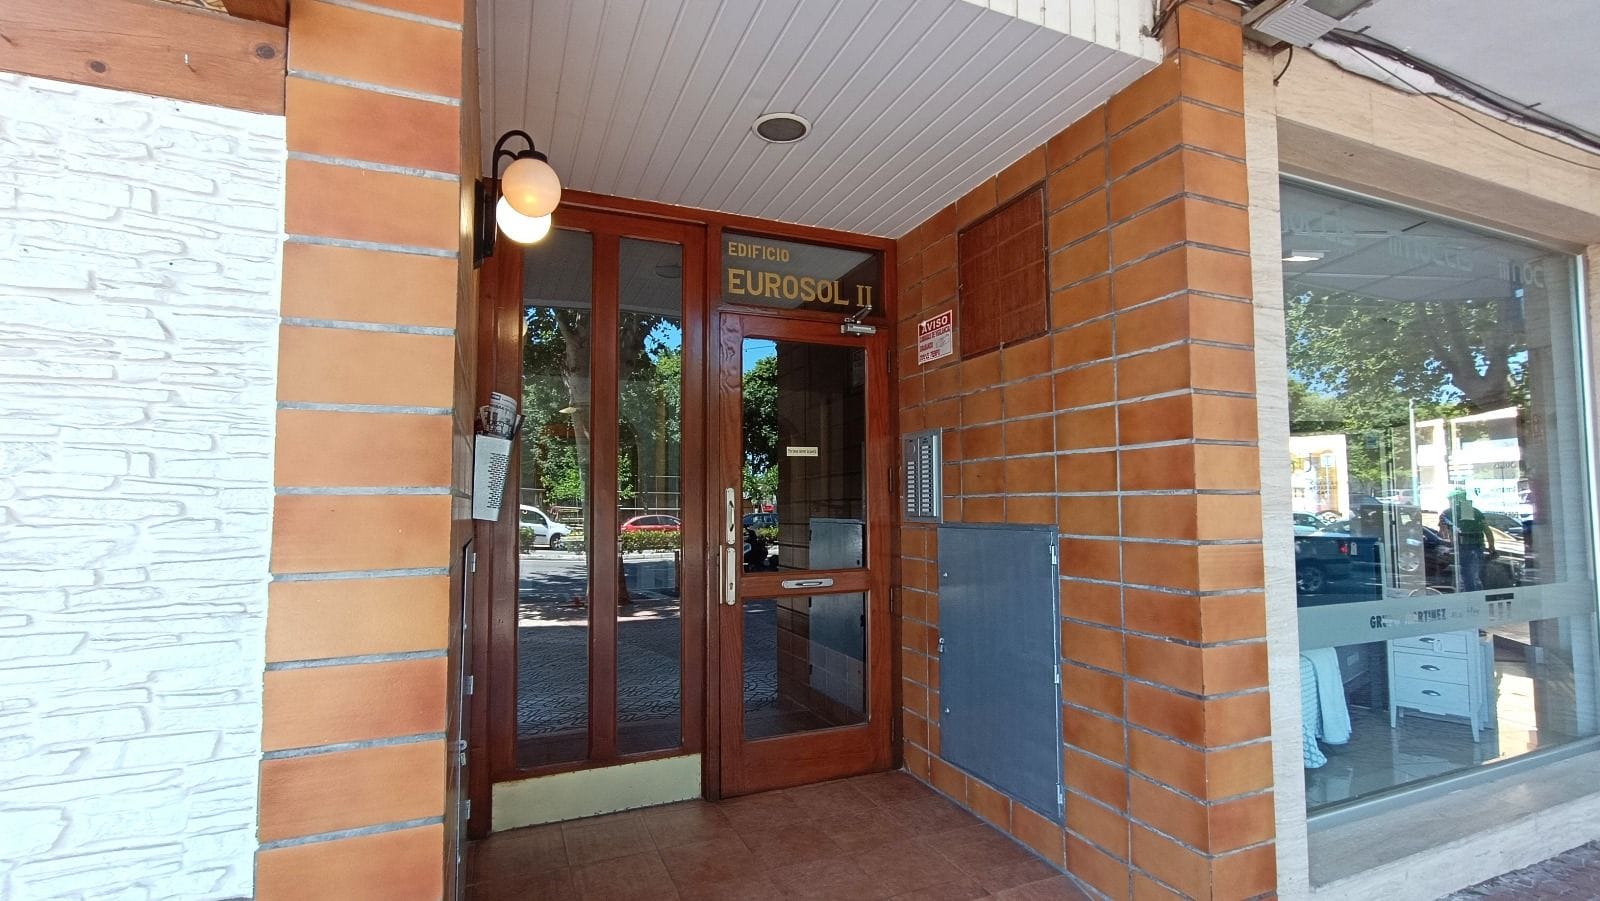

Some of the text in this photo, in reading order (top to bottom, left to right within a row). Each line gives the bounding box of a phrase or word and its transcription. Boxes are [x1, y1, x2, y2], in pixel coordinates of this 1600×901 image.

[728, 242, 790, 262] EDIFICIO
[728, 268, 873, 307] EUROSOL II
[921, 315, 948, 334] AVISO
